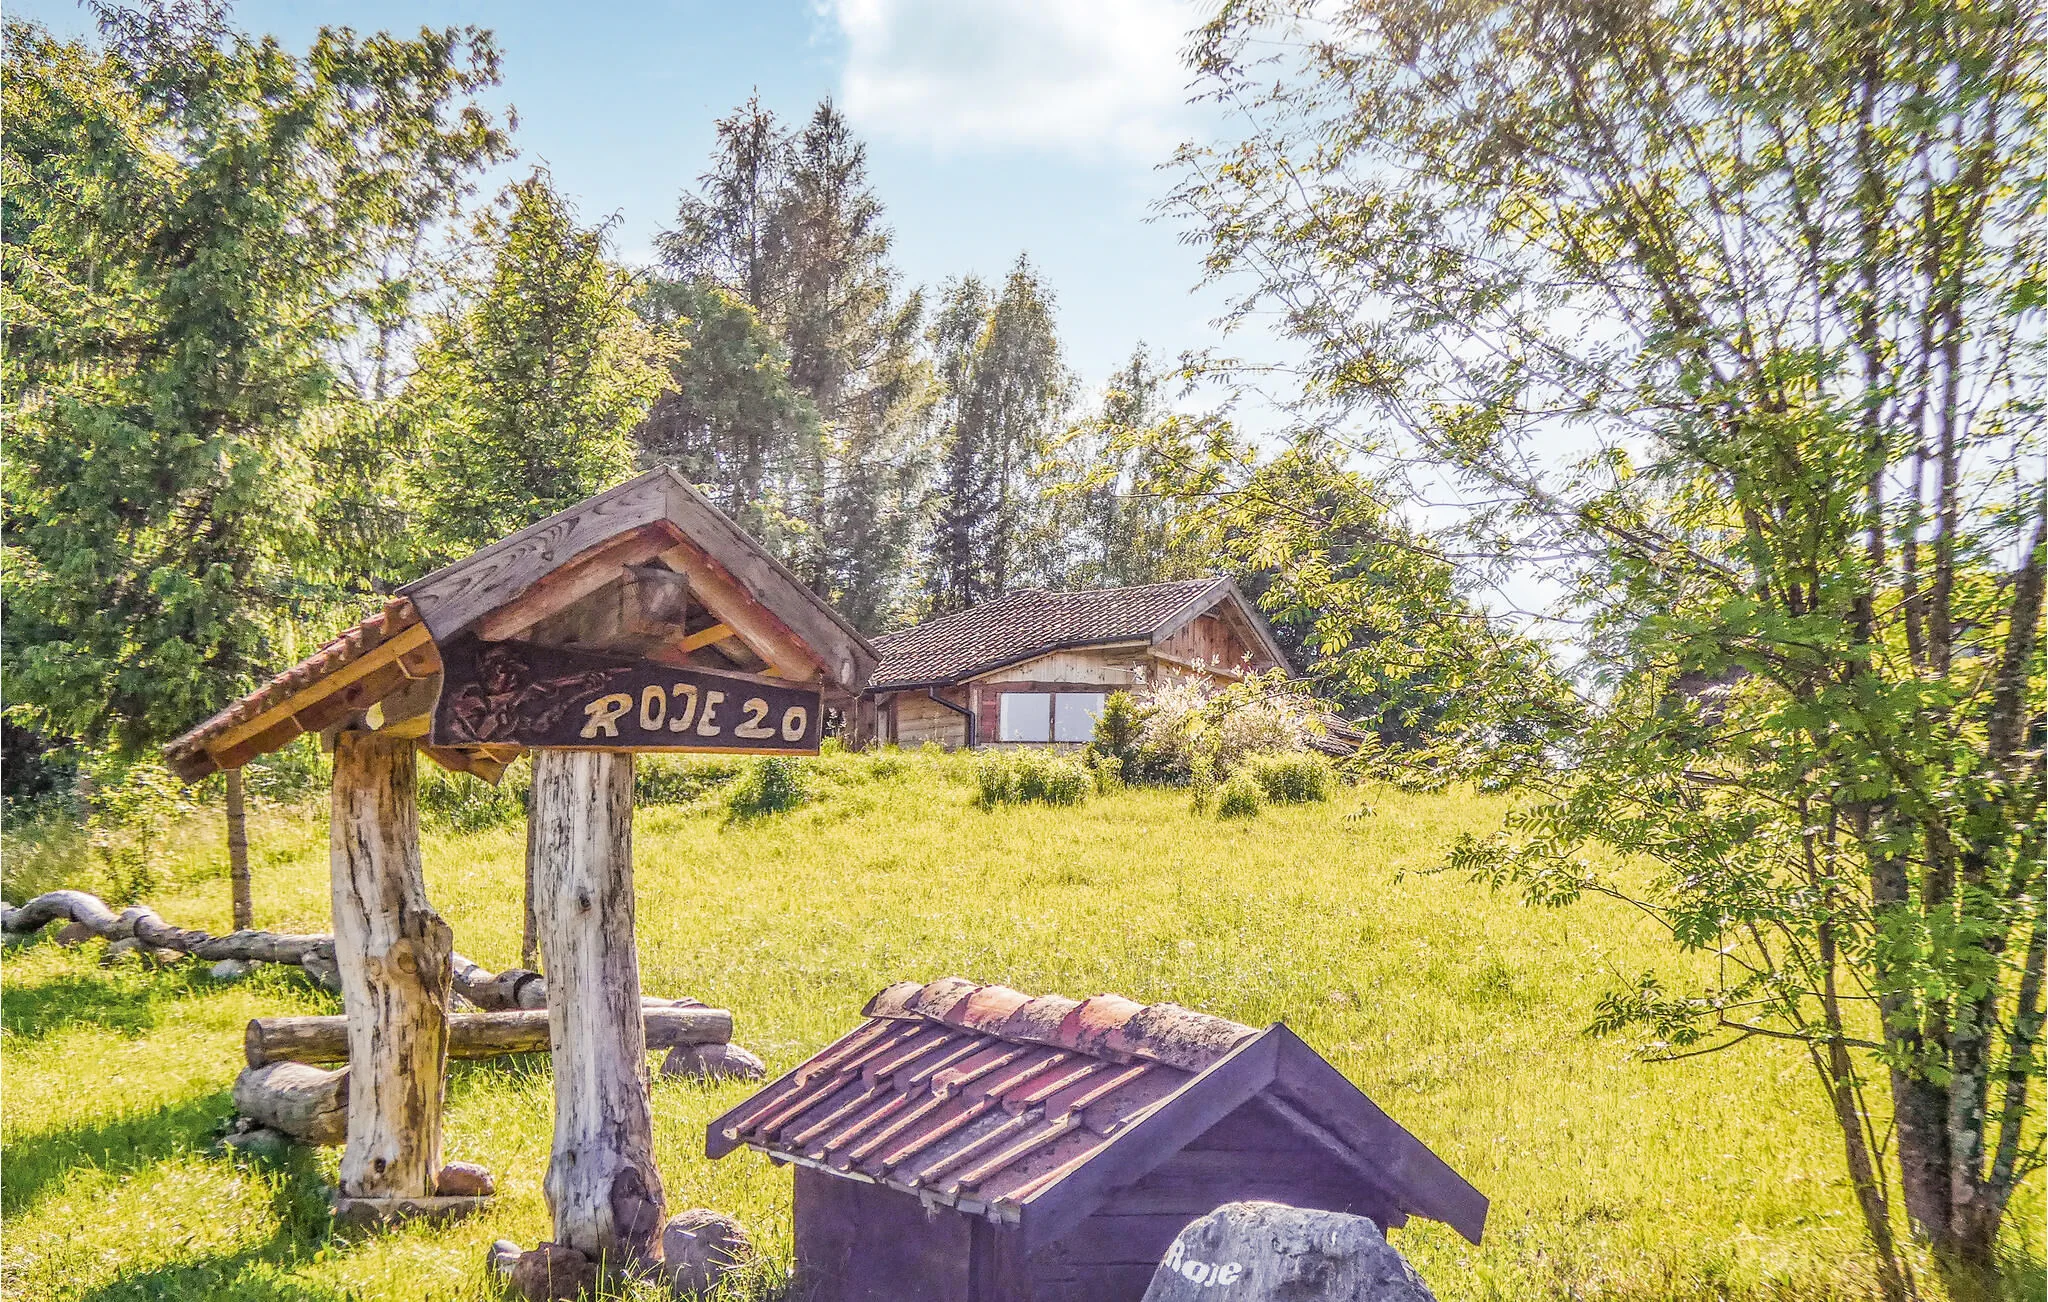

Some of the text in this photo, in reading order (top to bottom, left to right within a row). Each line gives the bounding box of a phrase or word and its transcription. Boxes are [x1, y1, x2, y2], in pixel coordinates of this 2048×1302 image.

[581, 683, 806, 741] ROJE 20
[1165, 1239, 1242, 1287] Roje
